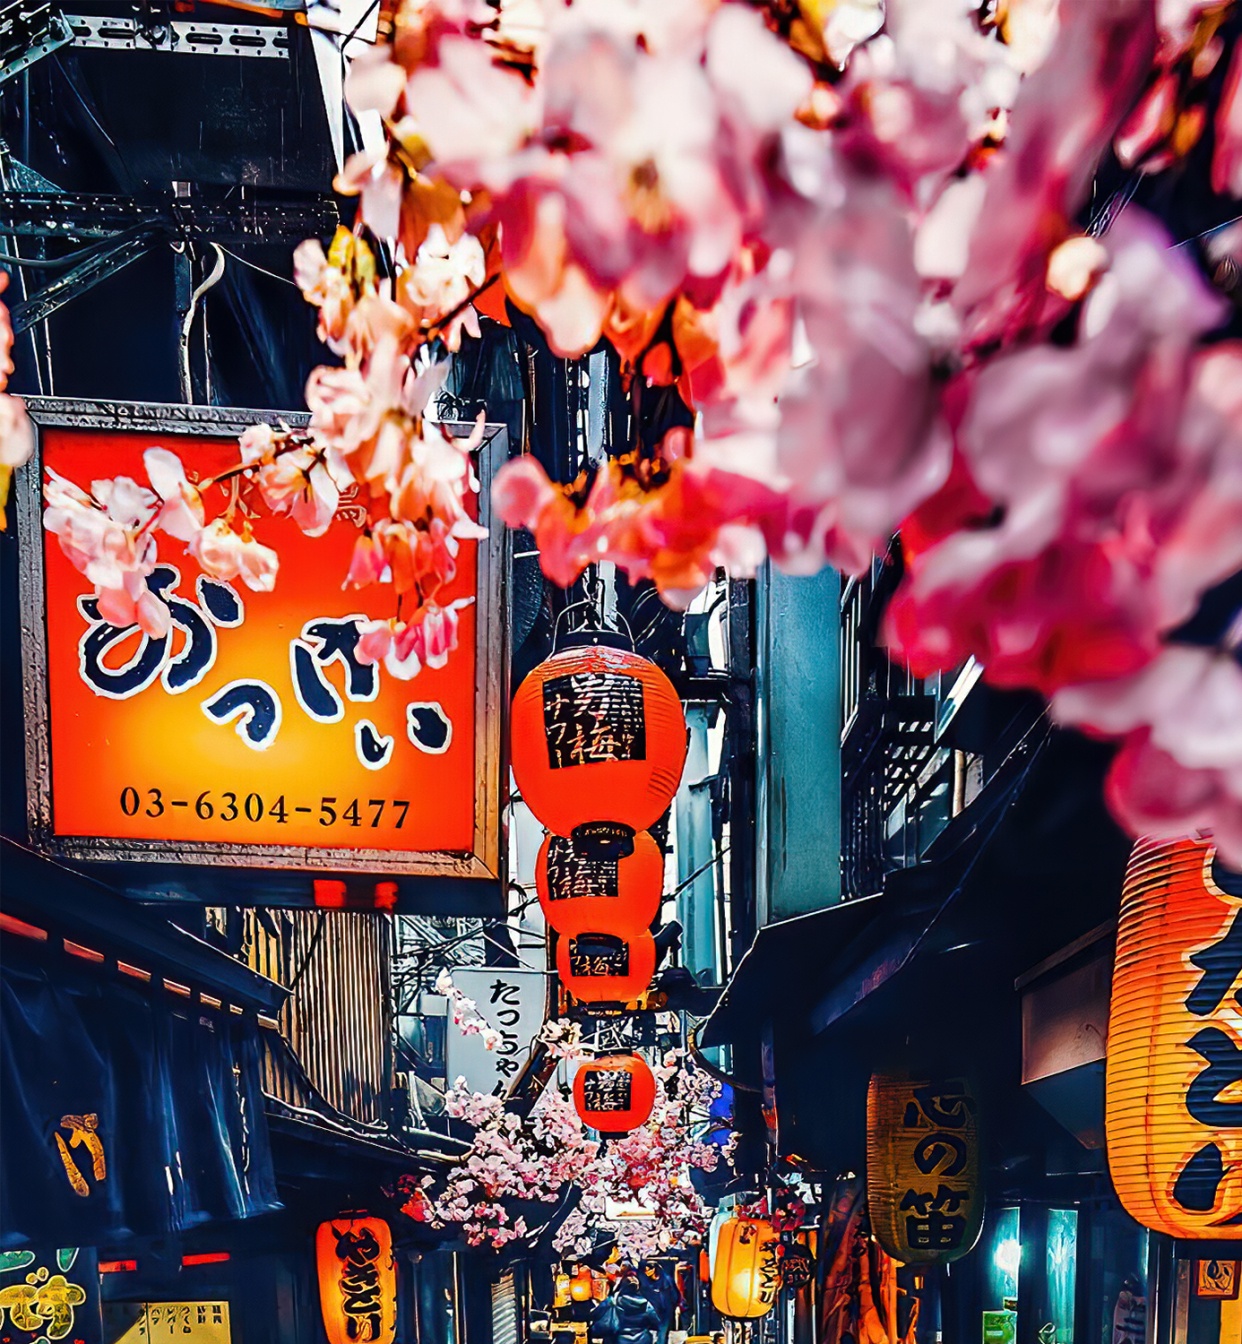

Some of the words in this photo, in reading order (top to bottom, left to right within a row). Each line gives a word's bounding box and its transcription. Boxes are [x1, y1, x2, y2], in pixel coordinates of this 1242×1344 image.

[119, 785, 411, 829] 03-6304-5477
[332, 1227, 382, 1342] やきとり
